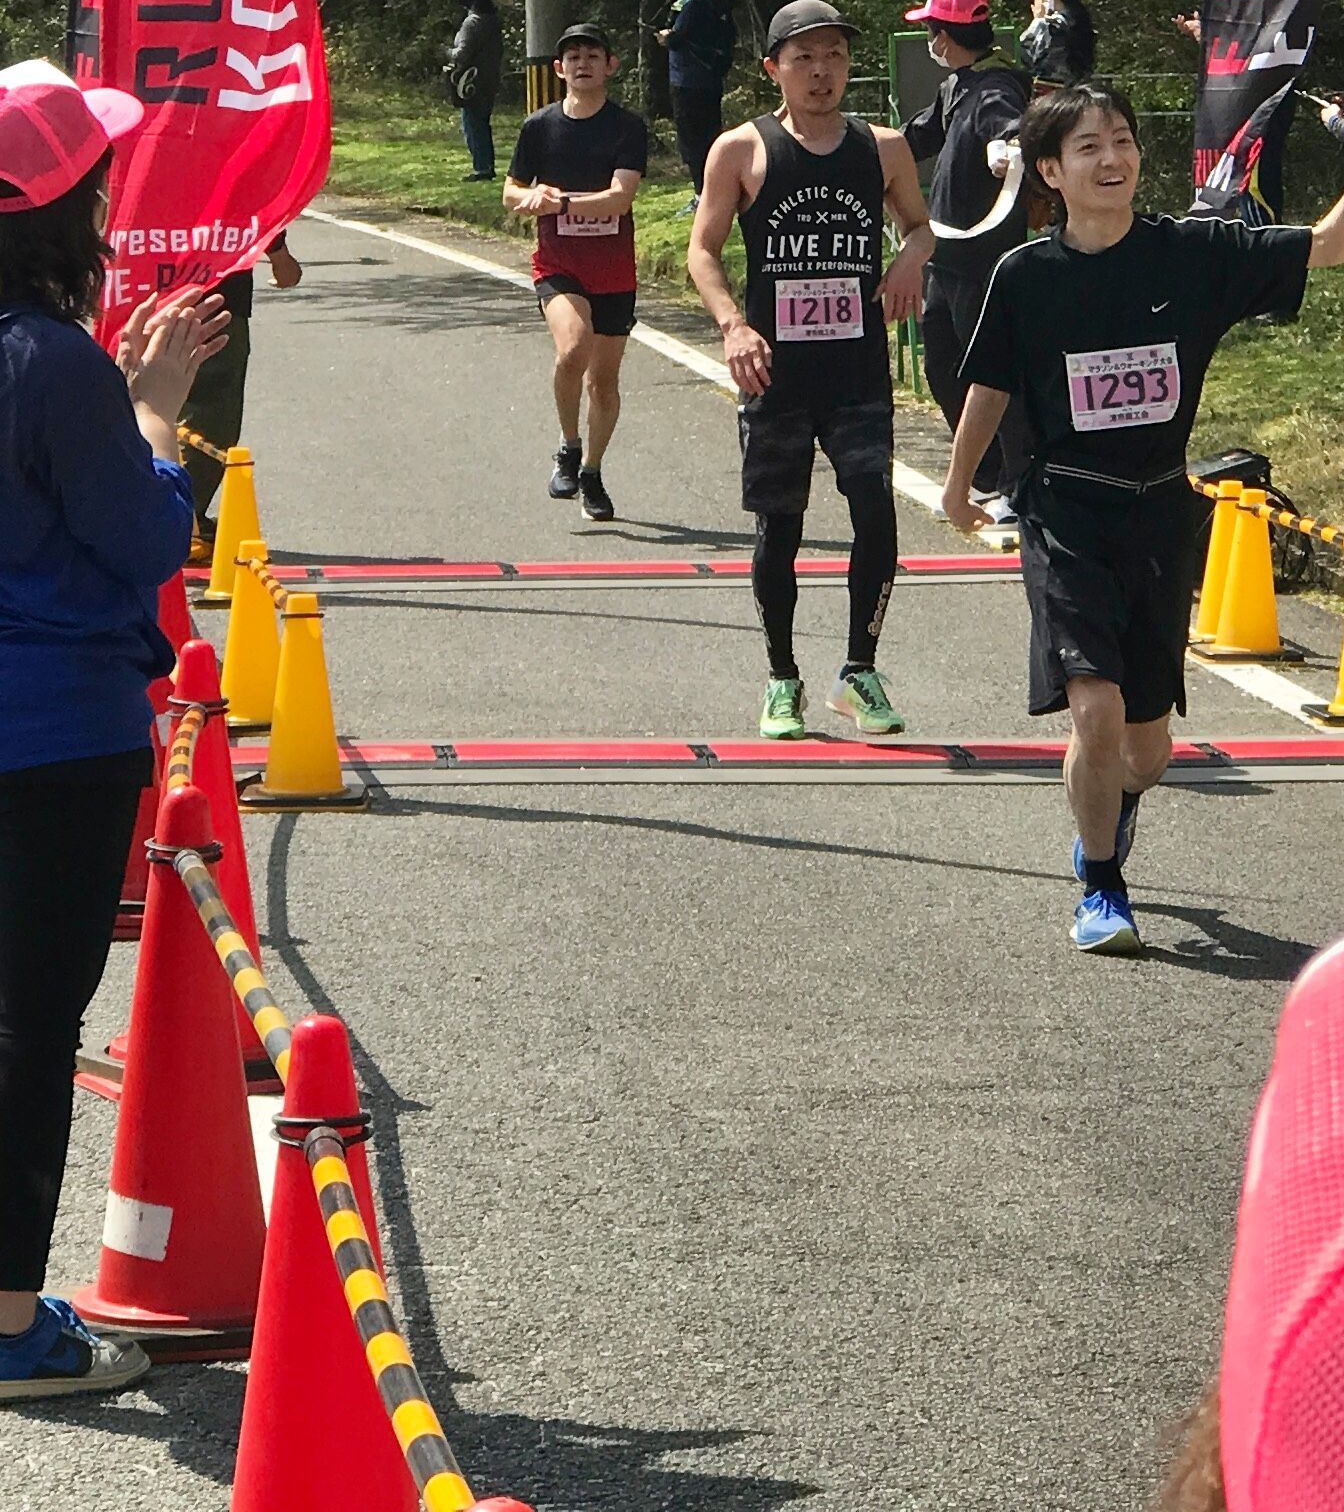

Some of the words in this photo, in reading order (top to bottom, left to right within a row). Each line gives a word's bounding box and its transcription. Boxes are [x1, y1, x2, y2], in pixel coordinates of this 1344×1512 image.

[768, 186, 829, 229] ATHLETIC
[835, 188, 873, 228] GOODS
[766, 234, 819, 259] LIVE
[832, 233, 872, 261] FIT.
[788, 295, 852, 326] 1218
[1084, 367, 1169, 411] 1293
